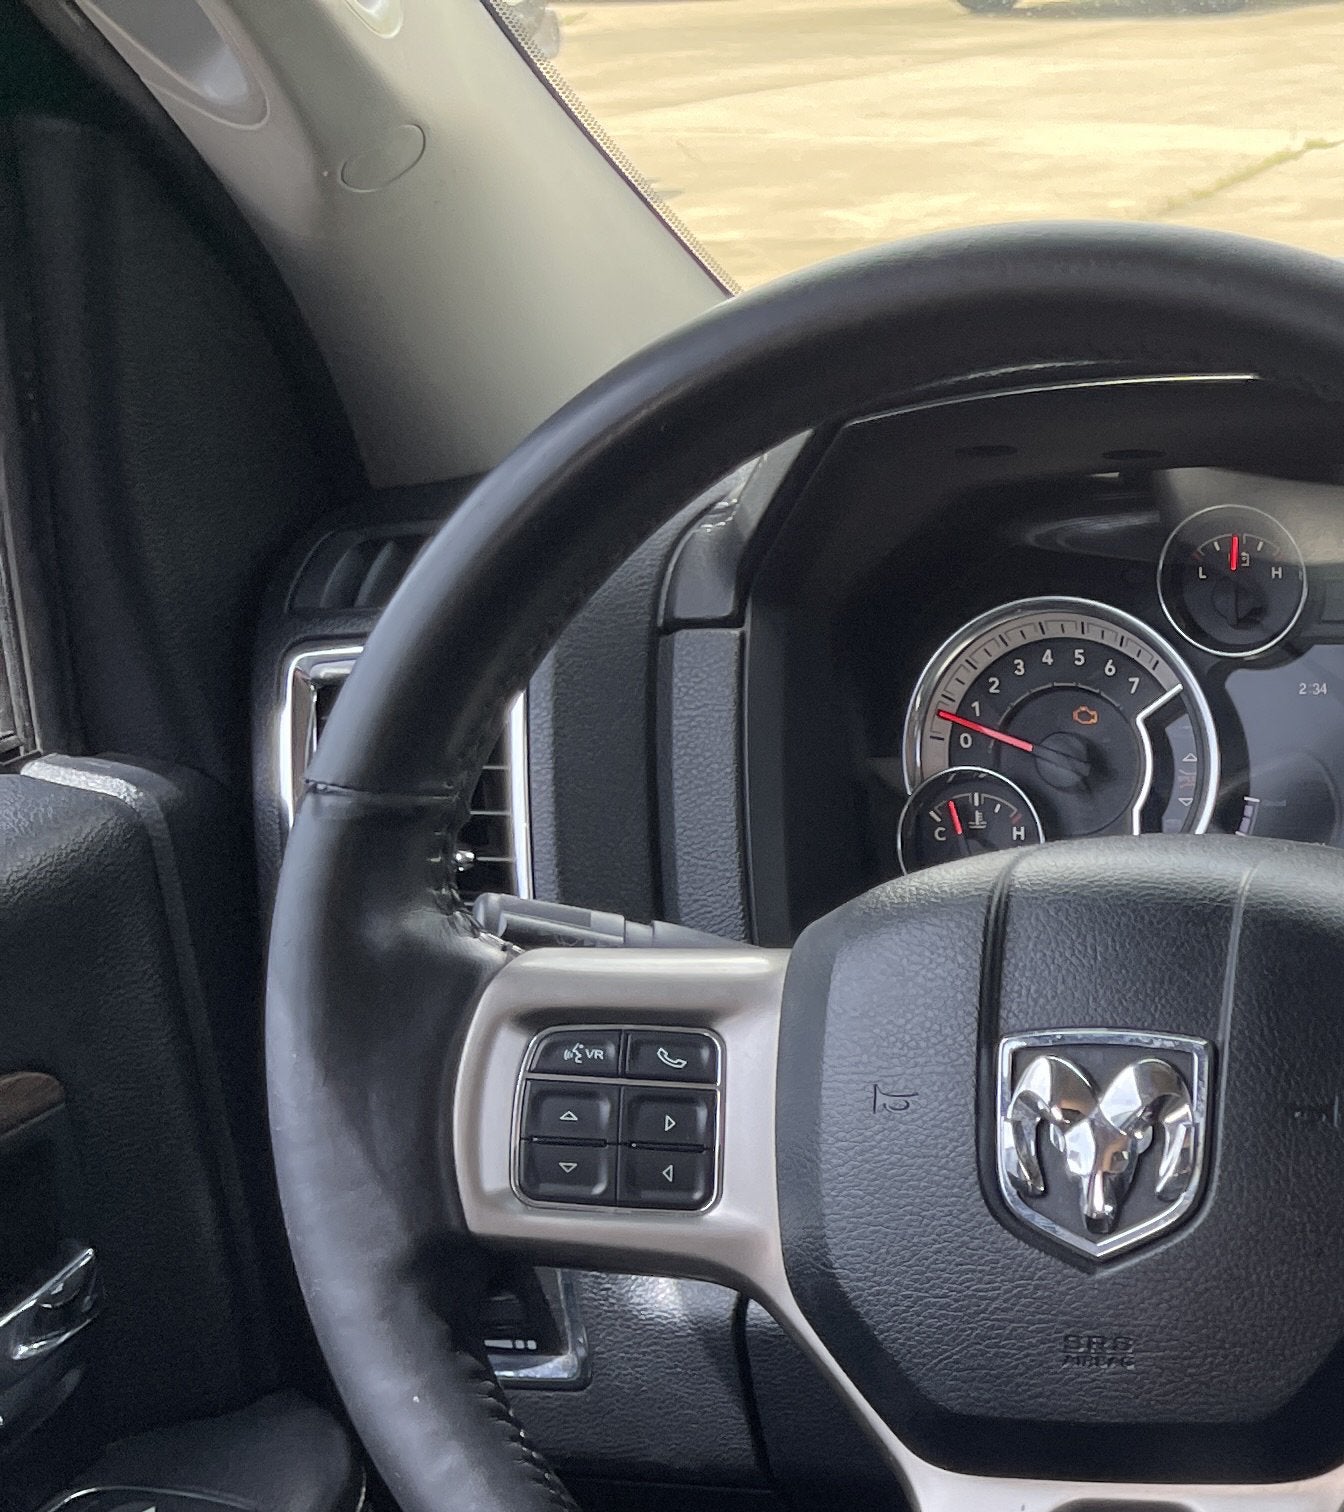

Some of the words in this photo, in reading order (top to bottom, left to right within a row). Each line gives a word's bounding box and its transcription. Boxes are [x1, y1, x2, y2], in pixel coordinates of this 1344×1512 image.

[1198, 566, 1206, 577] L
[1271, 566, 1281, 578] H
[1042, 649, 1053, 664] 4
[1074, 649, 1084, 664] 5
[1014, 659, 1024, 674] 3
[1104, 659, 1115, 675] 6
[988, 678, 999, 692] 2
[1128, 677, 1139, 692] 7
[971, 702, 980, 715] 1
[959, 733, 971, 748] 0
[934, 827, 945, 840] C
[1013, 827, 1024, 840] H
[586, 1049, 604, 1060] VR
